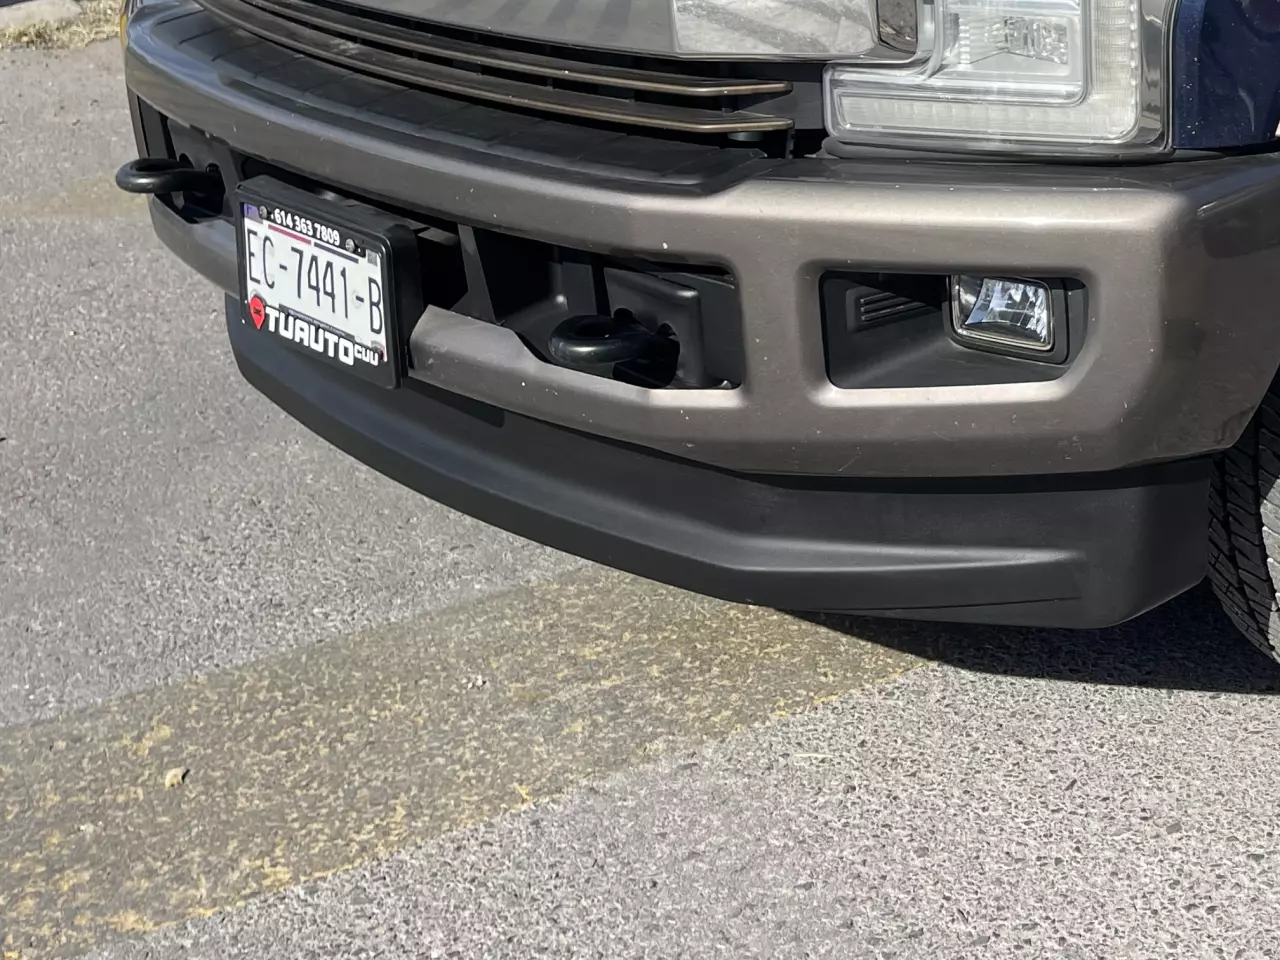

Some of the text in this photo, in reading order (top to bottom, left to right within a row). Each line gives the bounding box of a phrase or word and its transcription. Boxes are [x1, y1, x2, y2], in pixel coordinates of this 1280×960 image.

[274, 208, 341, 246] 614 363 7809
